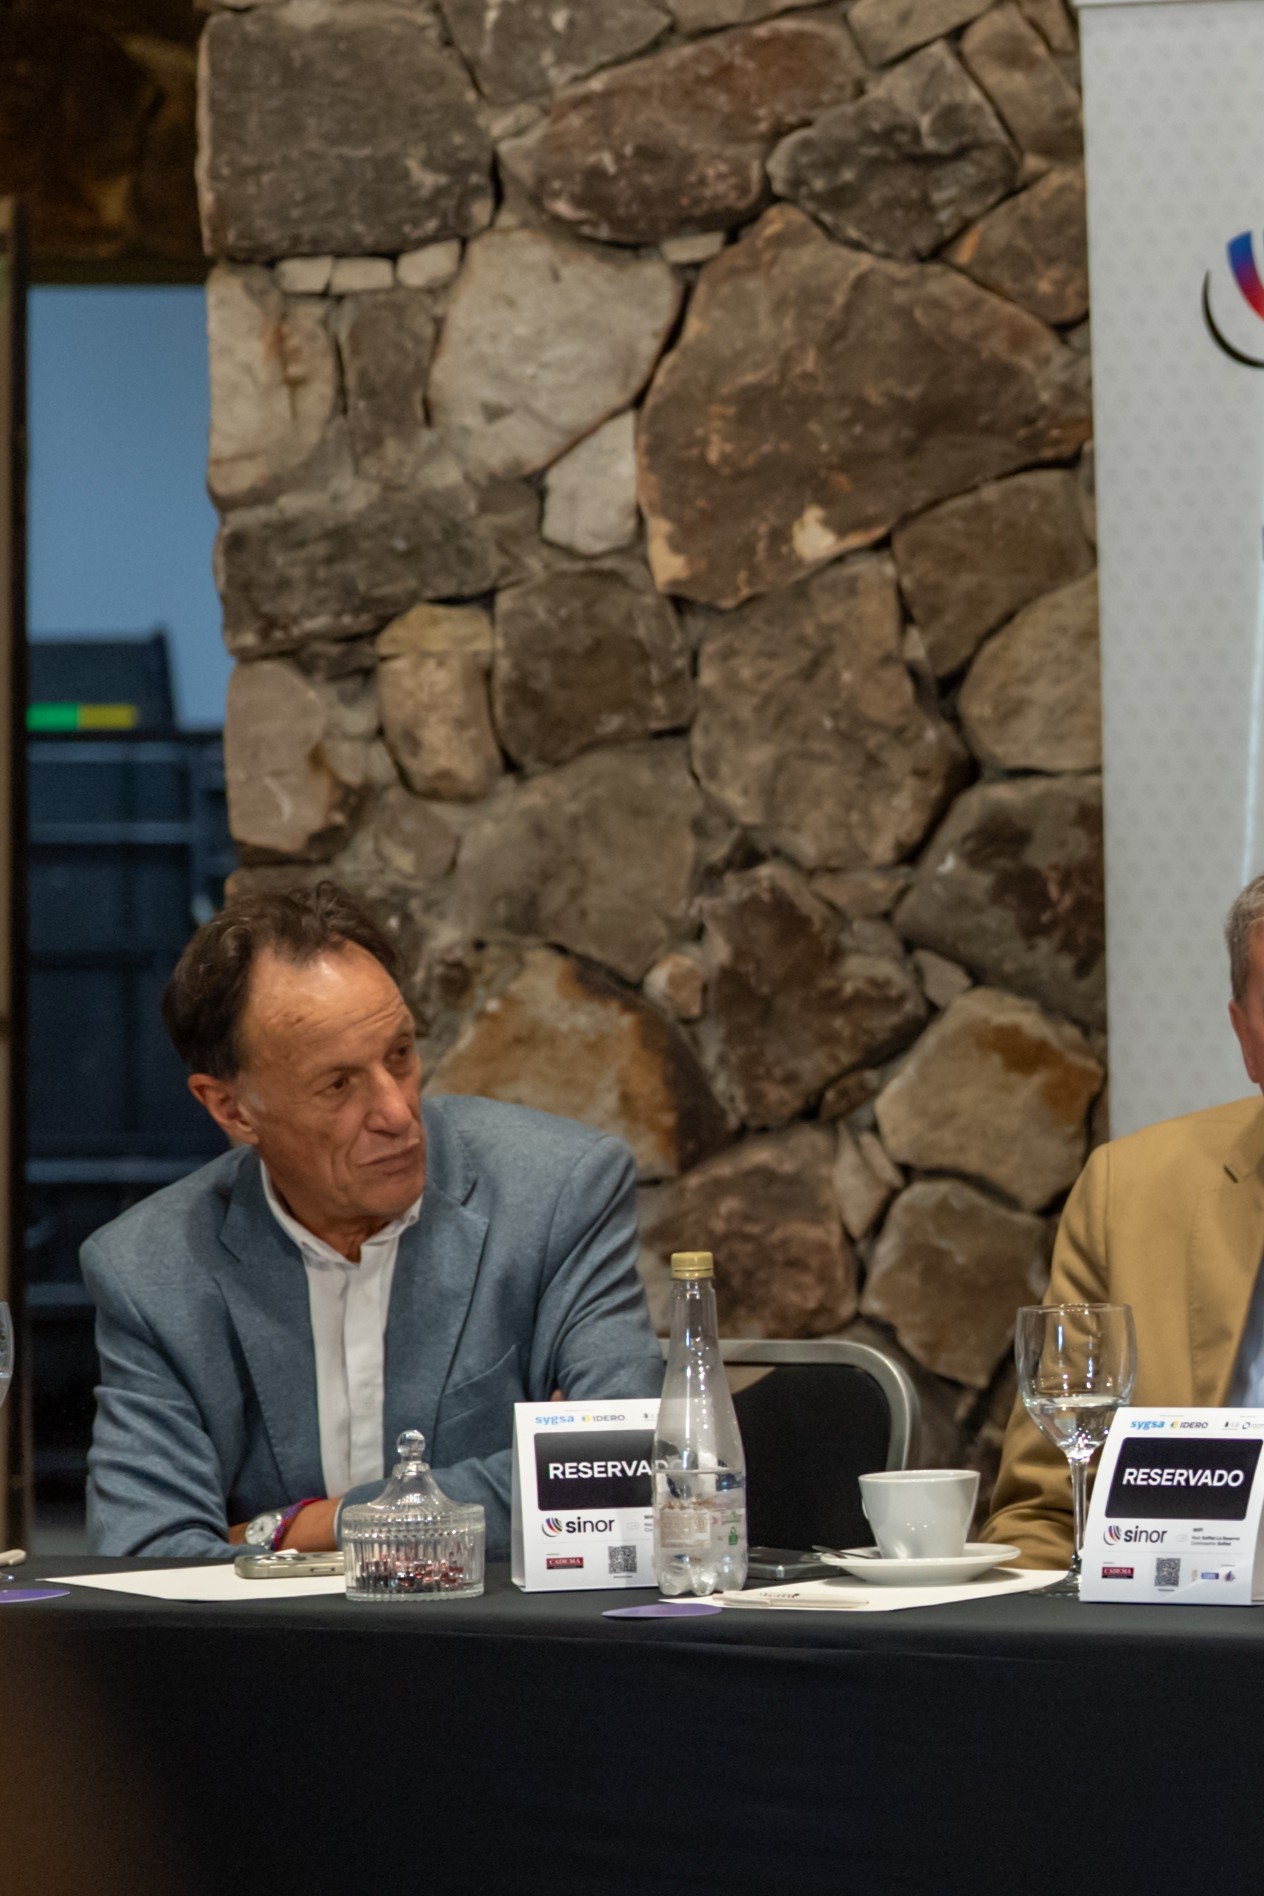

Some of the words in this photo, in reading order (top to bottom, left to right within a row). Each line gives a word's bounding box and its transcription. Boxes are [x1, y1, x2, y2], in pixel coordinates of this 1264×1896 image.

[535, 1415, 575, 1426] sygsa
[1130, 1420, 1166, 1430] sygsa
[1122, 1468, 1244, 1487] RESERVADO
[566, 1516, 616, 1534] sinor
[1123, 1525, 1168, 1543] sinor
